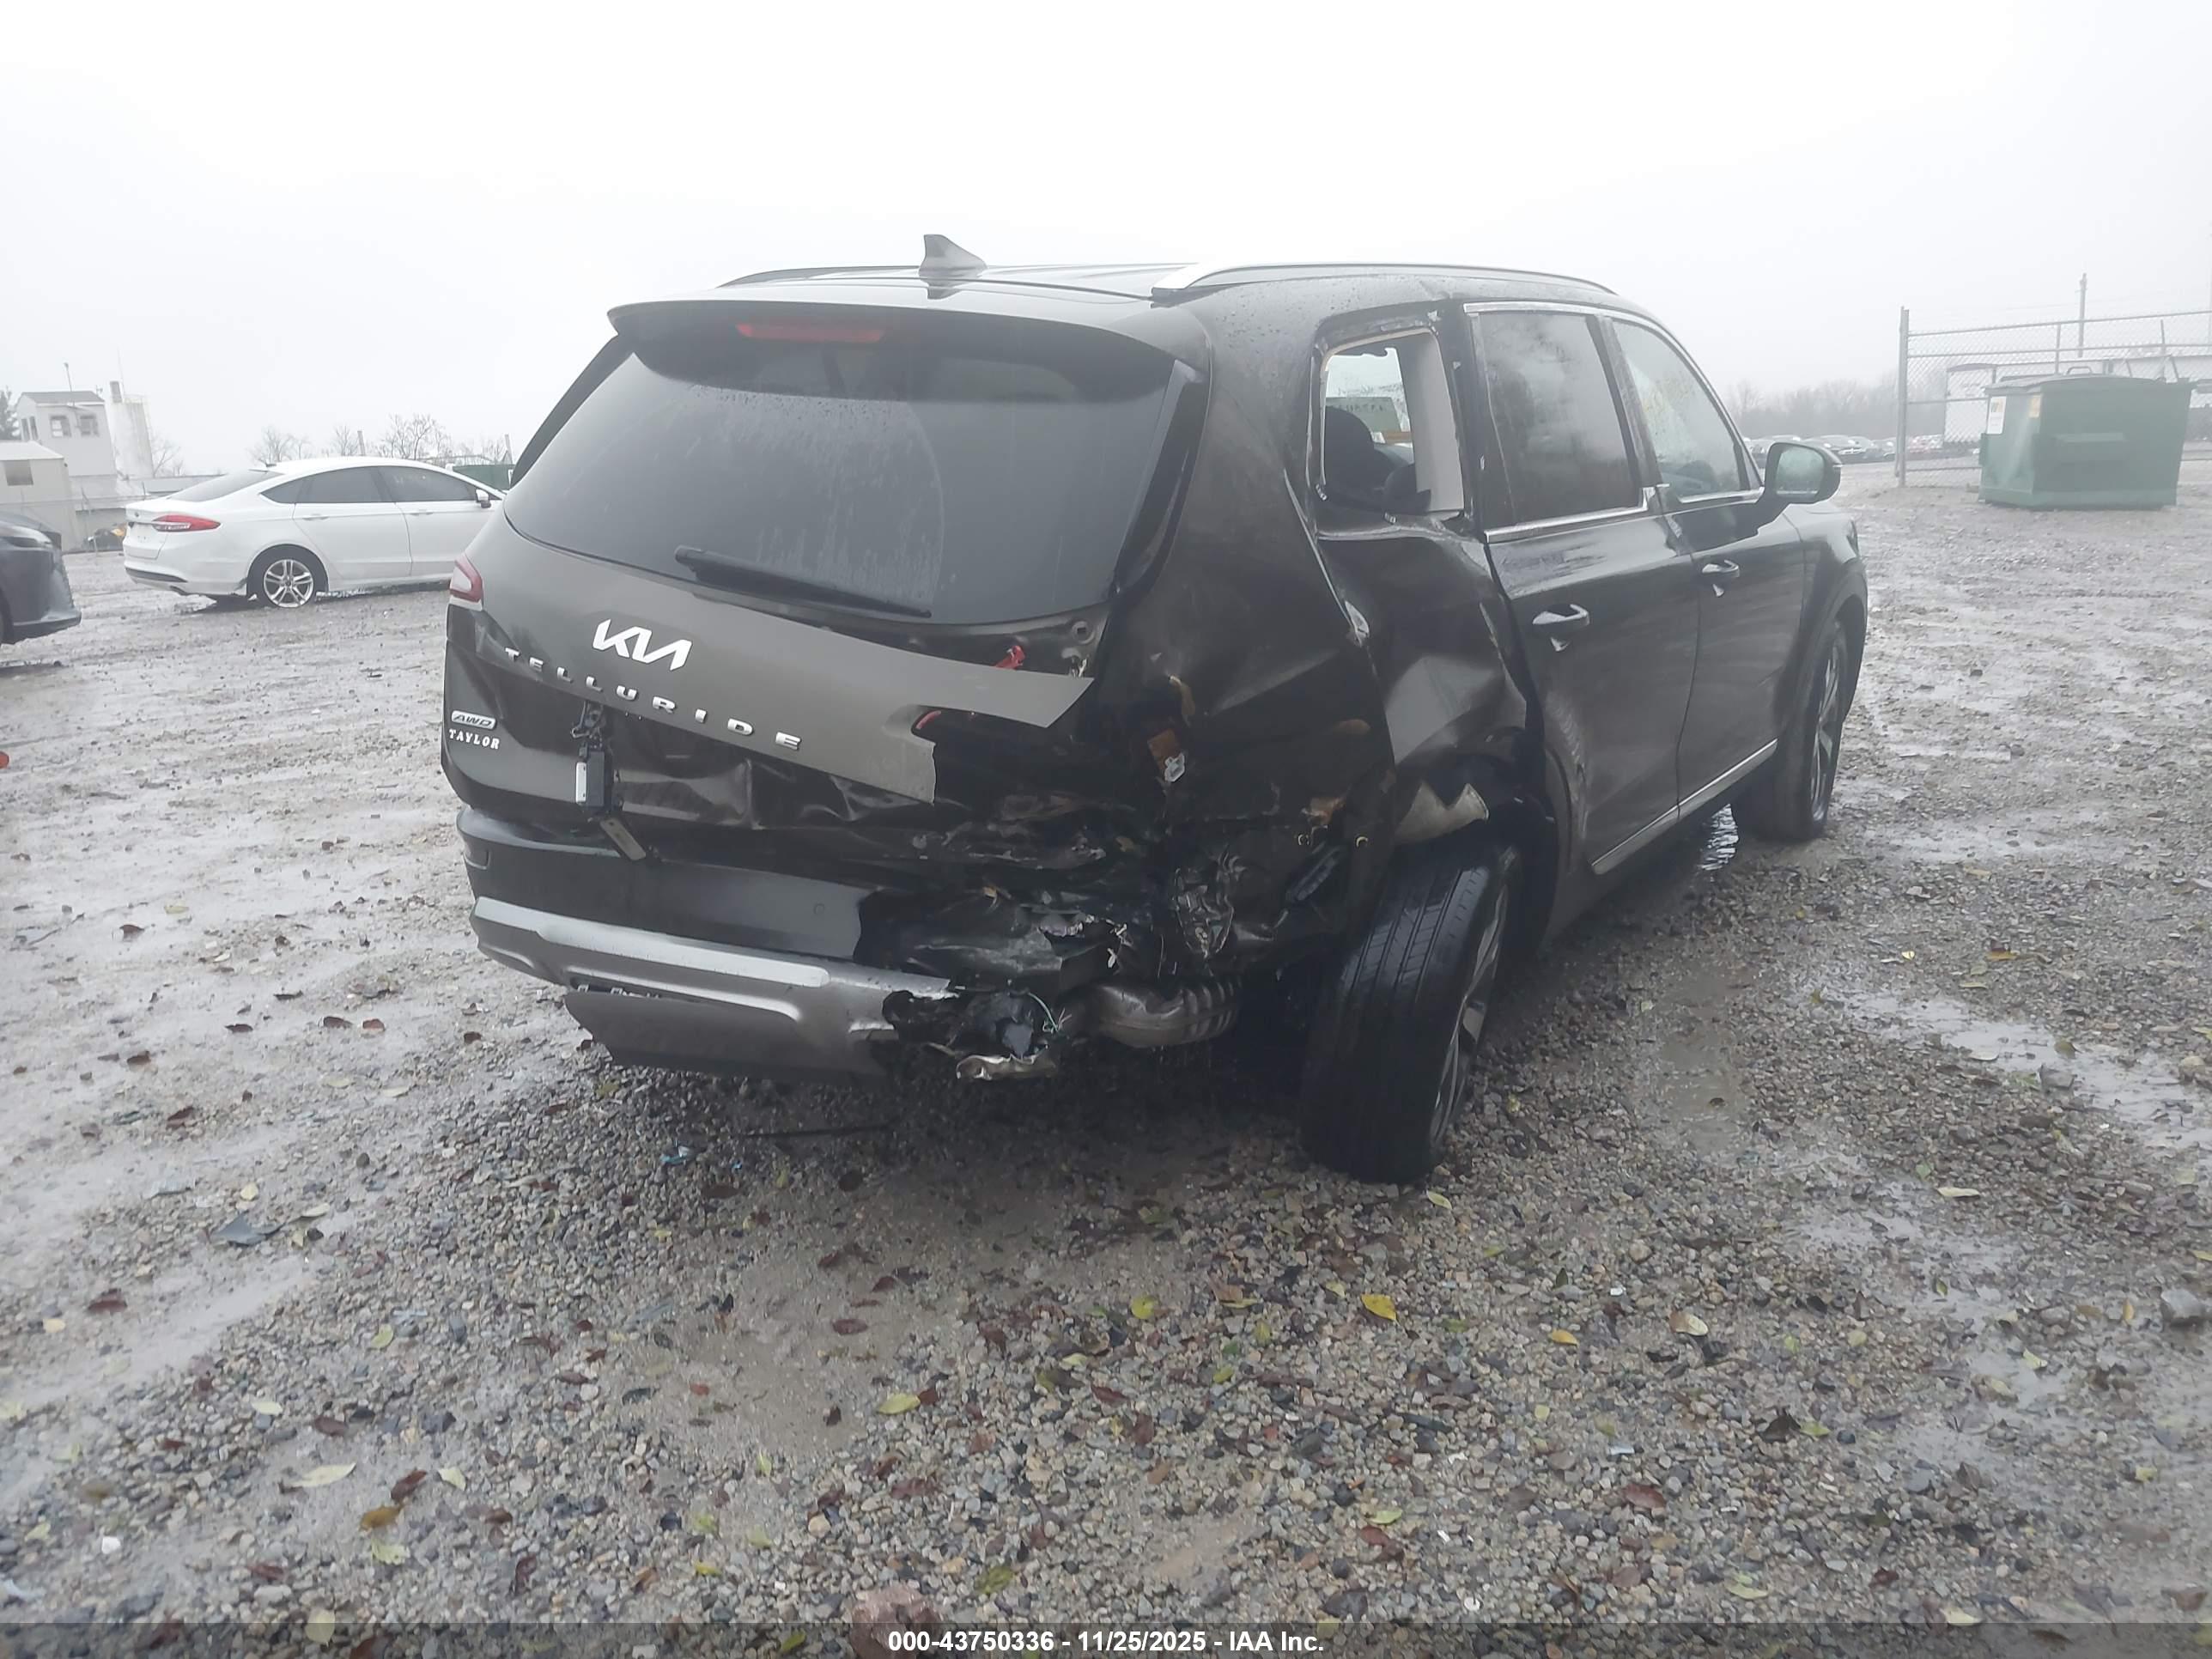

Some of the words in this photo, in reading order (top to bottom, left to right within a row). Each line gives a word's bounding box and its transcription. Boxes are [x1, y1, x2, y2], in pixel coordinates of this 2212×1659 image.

[592, 618, 693, 671] KIA
[504, 647, 802, 751] TELLURIDE
[448, 727, 501, 750] TAYLOR
[453, 713, 494, 727] AWD
